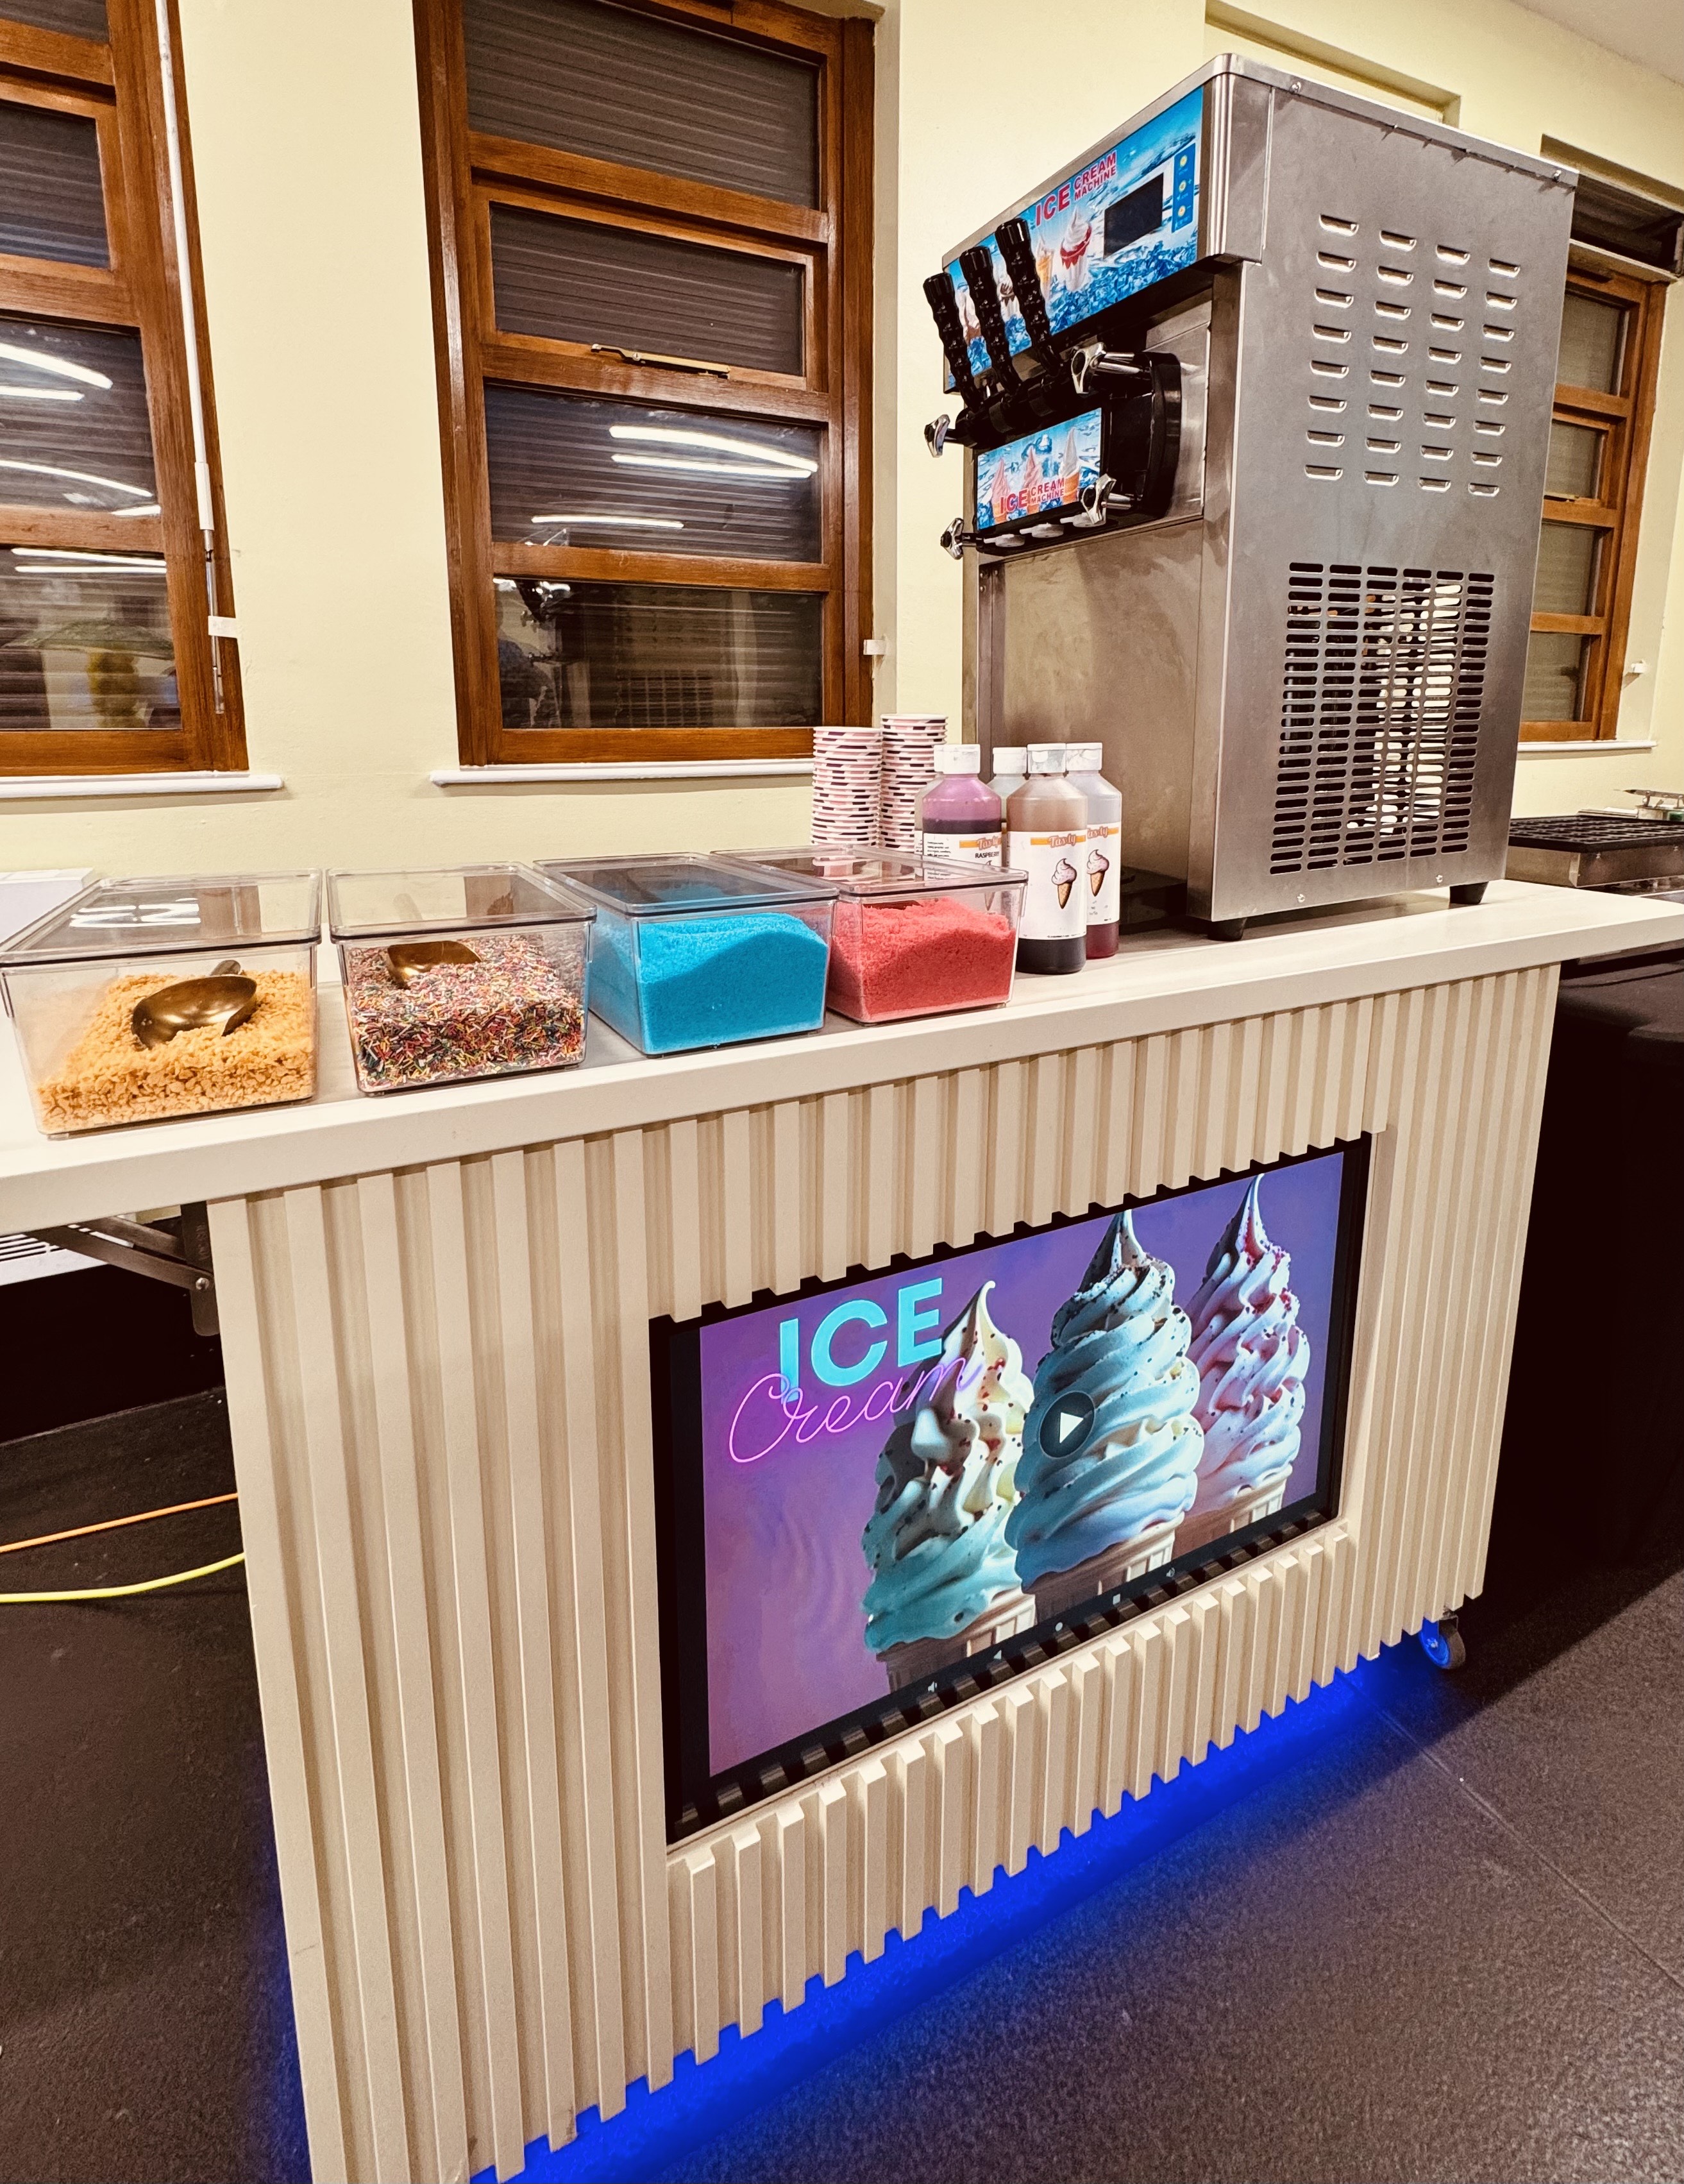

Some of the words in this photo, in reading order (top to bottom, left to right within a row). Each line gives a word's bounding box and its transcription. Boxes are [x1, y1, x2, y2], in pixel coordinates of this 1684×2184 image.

[1036, 183, 1070, 226] ICE
[1074, 151, 1116, 190] CREAM
[1074, 165, 1116, 201] MACHINE
[1000, 489, 1027, 514] ICE
[1031, 477, 1065, 496] CREAM
[1031, 488, 1065, 504] MACHINE
[1088, 826, 1108, 838] asty
[779, 1277, 943, 1405] ICE
[729, 1357, 982, 1463] Cream
